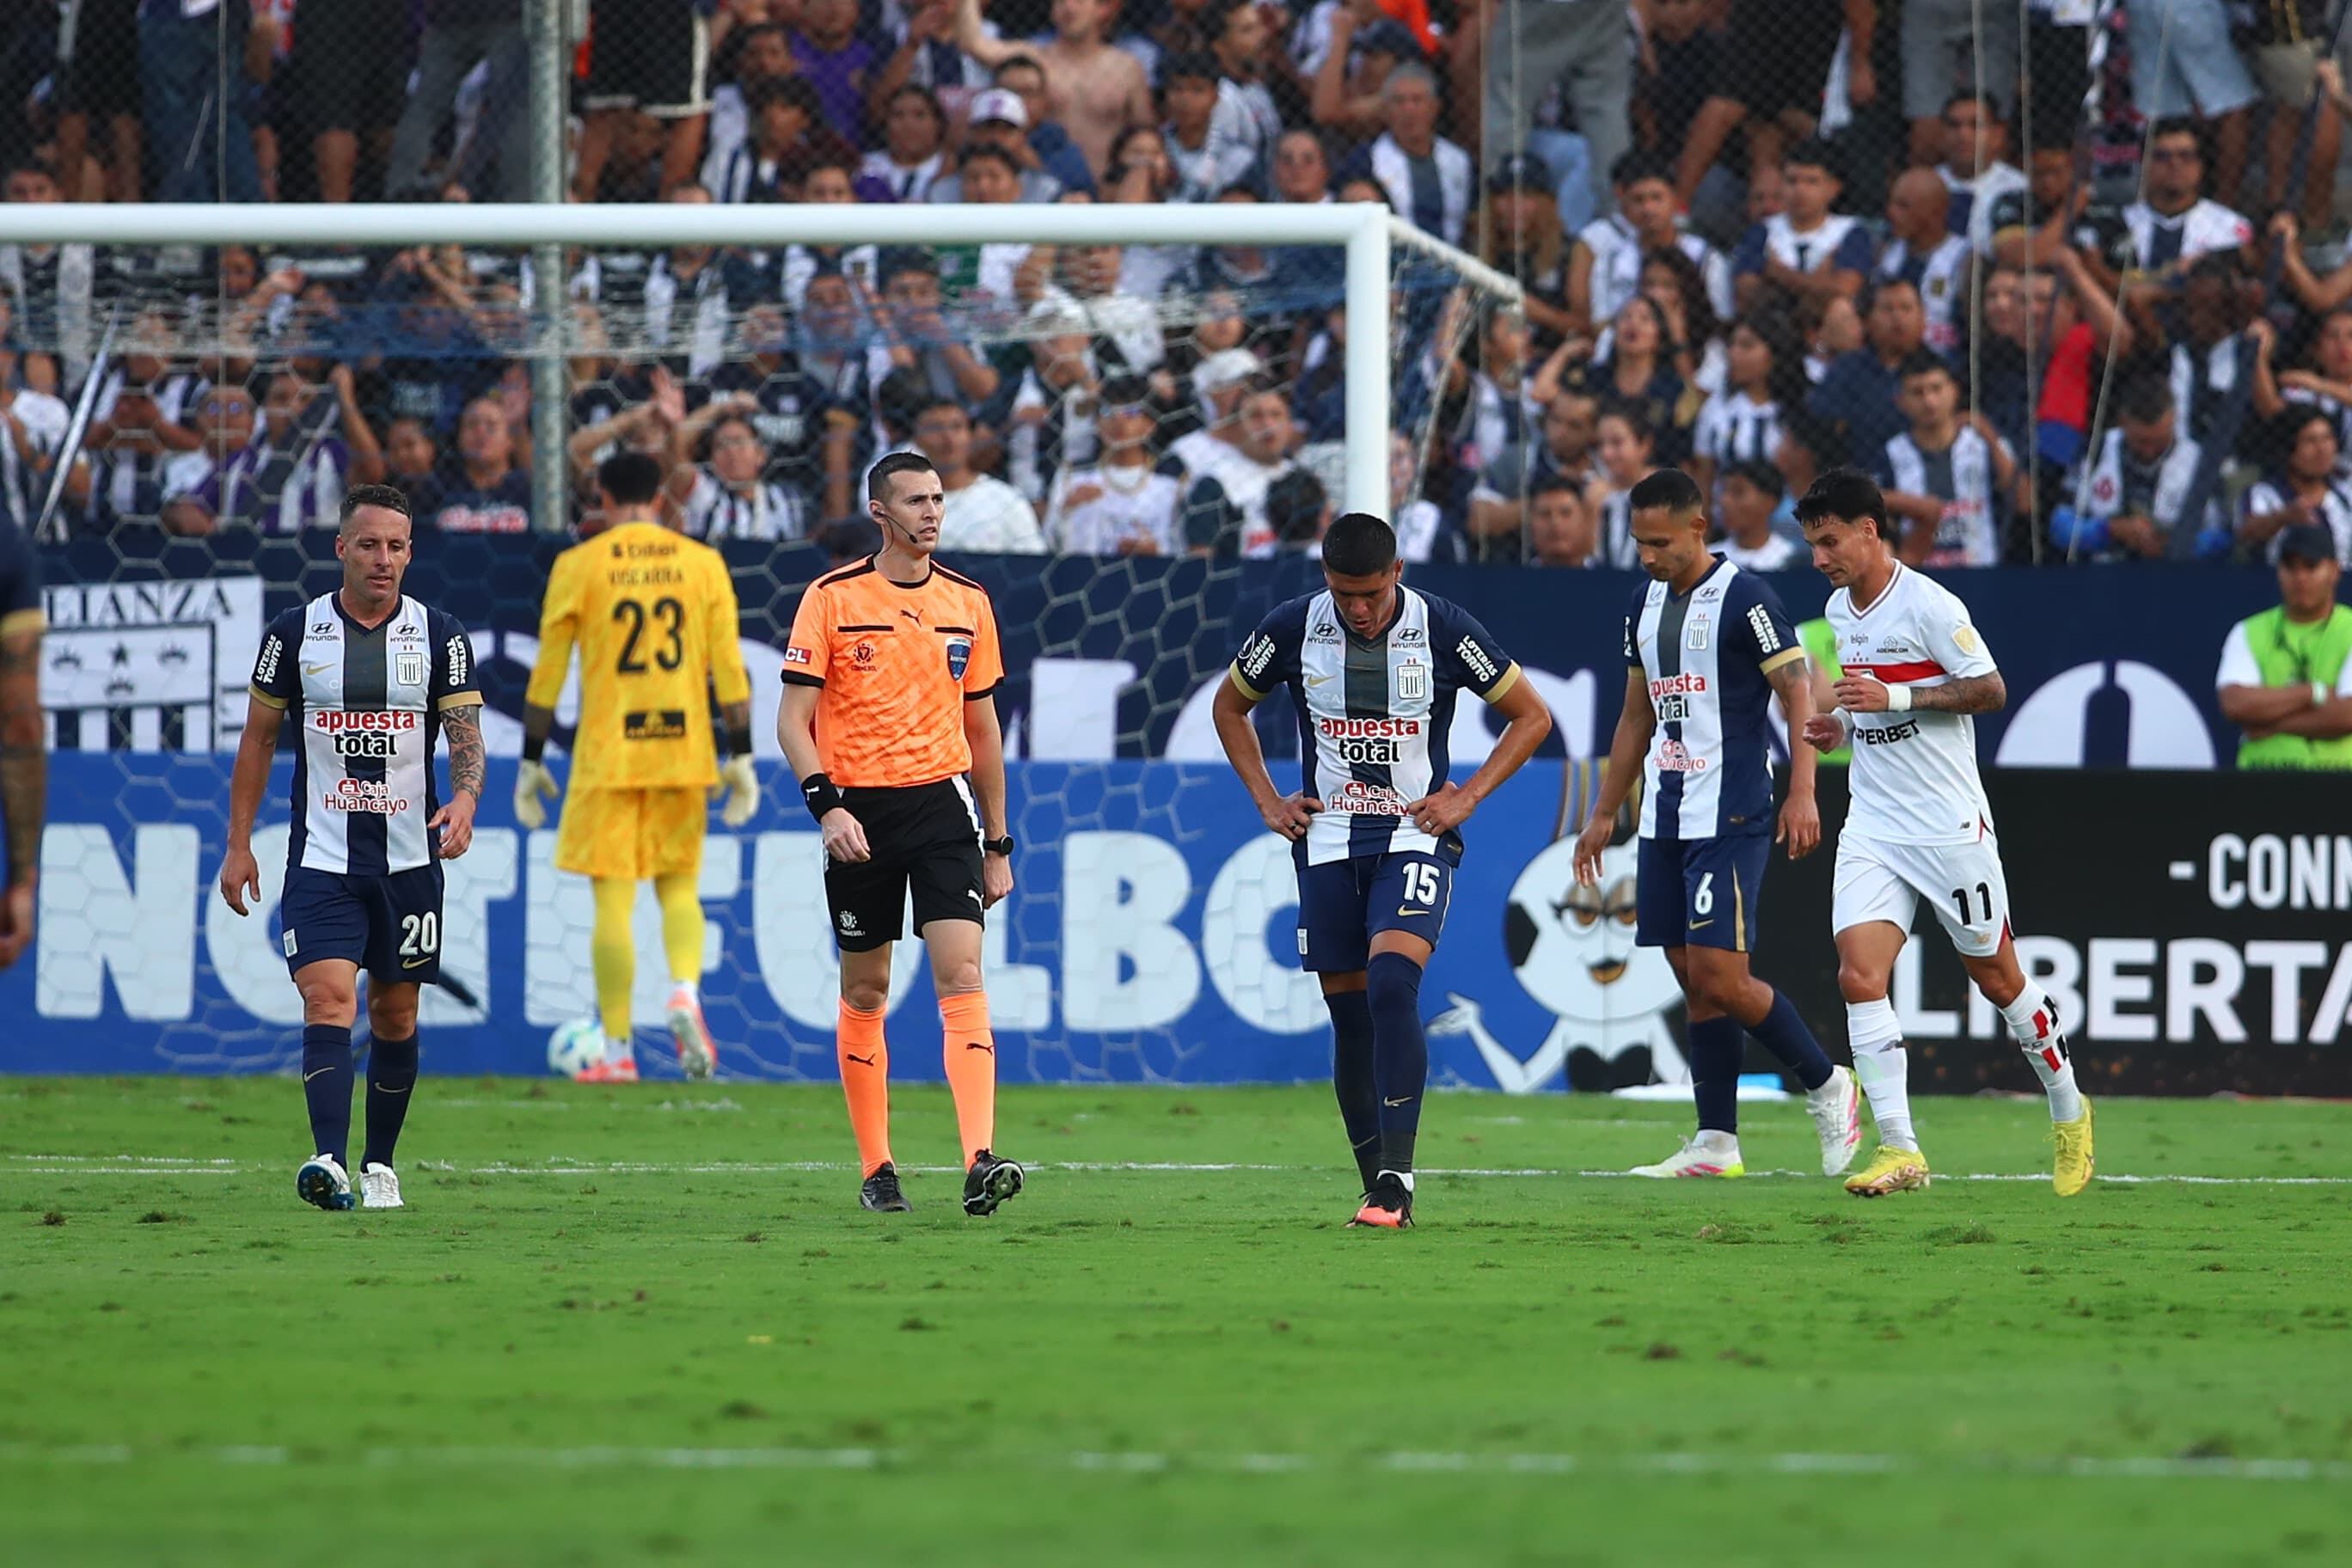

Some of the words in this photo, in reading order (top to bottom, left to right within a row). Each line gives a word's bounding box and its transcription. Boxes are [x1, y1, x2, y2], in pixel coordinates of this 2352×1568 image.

[45, 580, 232, 627] LIANZA
[612, 597, 685, 676] 23
[1747, 608, 1772, 653] TORITO
[263, 640, 283, 683] TORITO
[446, 638, 459, 686] TORITO
[785, 647, 807, 663] CL
[1248, 643, 1276, 679] TORITO
[1456, 642, 1490, 683] TORITO
[315, 710, 415, 732] apuesta
[1320, 718, 1419, 739] apuesta
[1853, 718, 1920, 745] PERBET
[334, 734, 397, 756] total
[1339, 739, 1400, 763] total
[324, 794, 407, 816] Huancayo
[361, 781, 389, 798] Caja
[1332, 794, 1409, 816] Huancay
[1369, 786, 1399, 800] Caja
[1402, 862, 1441, 905] 15
[1694, 872, 1714, 916] 6
[1951, 882, 1993, 926] 11
[399, 911, 438, 956] 20
